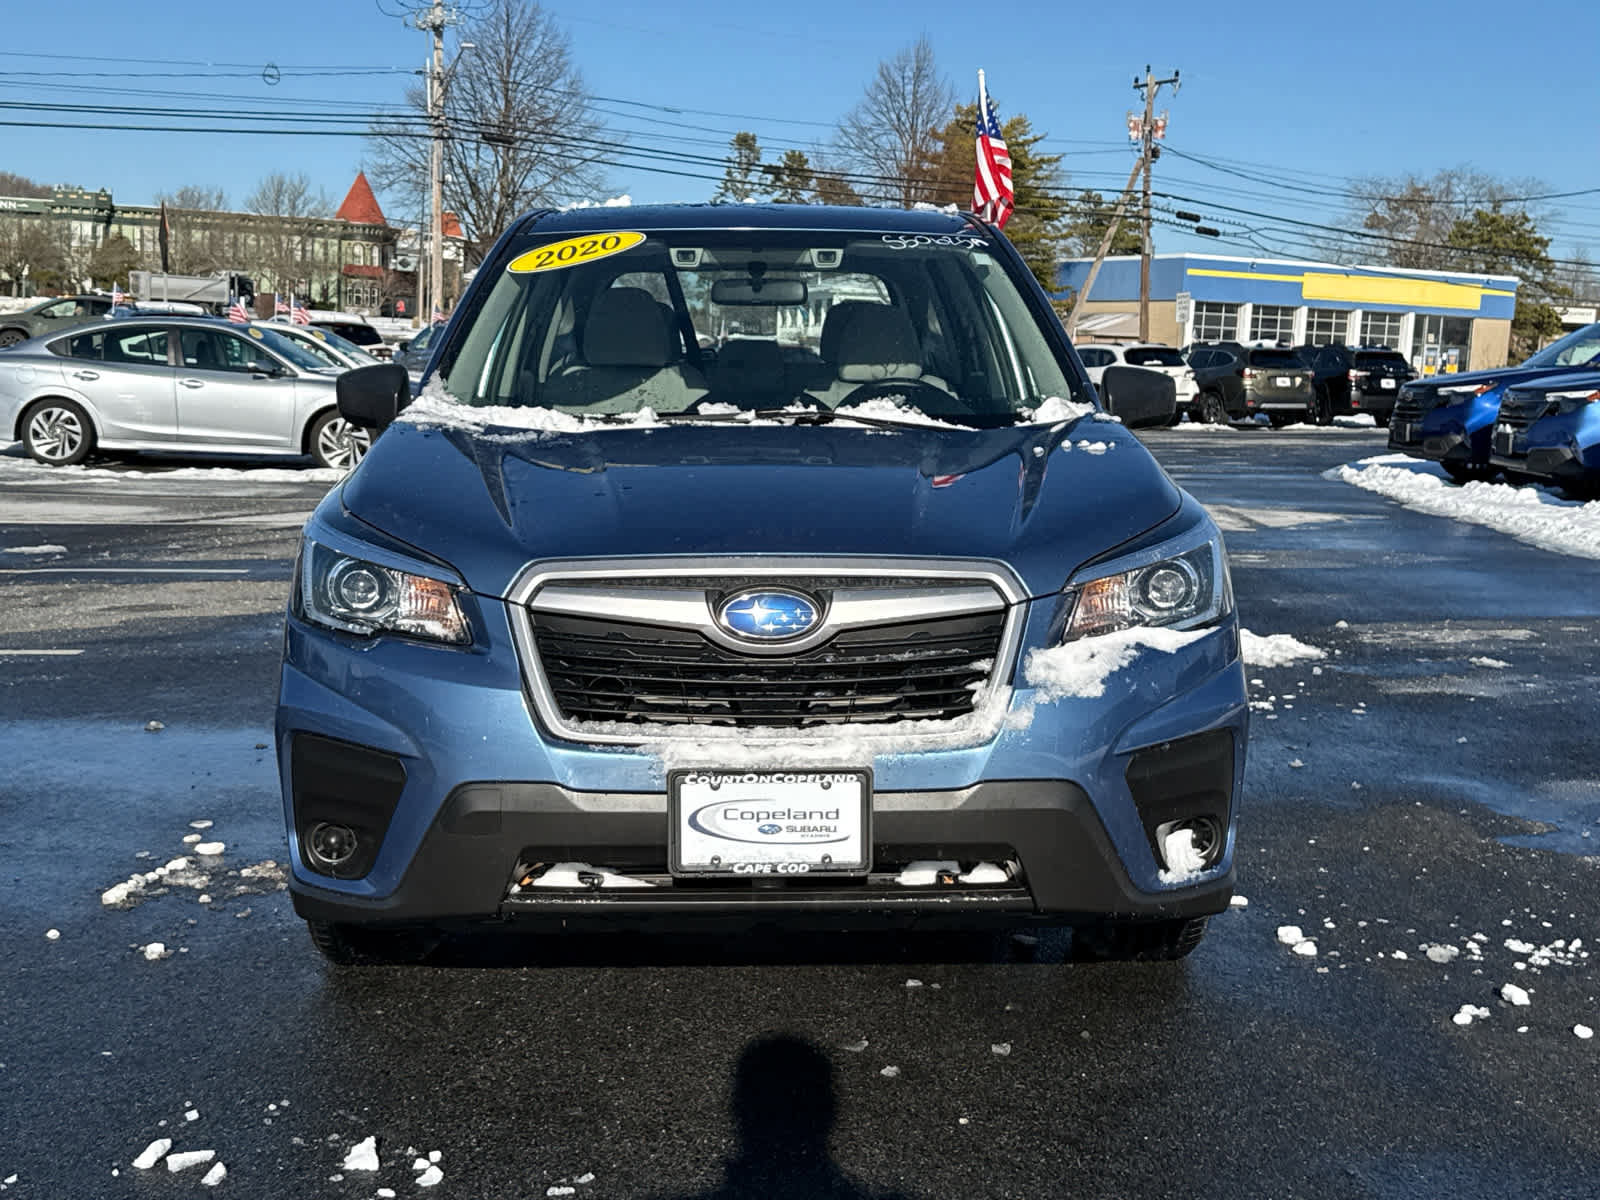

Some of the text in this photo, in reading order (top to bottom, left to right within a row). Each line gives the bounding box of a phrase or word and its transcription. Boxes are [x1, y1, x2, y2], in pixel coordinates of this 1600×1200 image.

[535, 235, 621, 268] 2020
[723, 808, 840, 822] Copeland
[785, 825, 838, 833] SUBARU
[733, 863, 810, 873] CAPE COD
